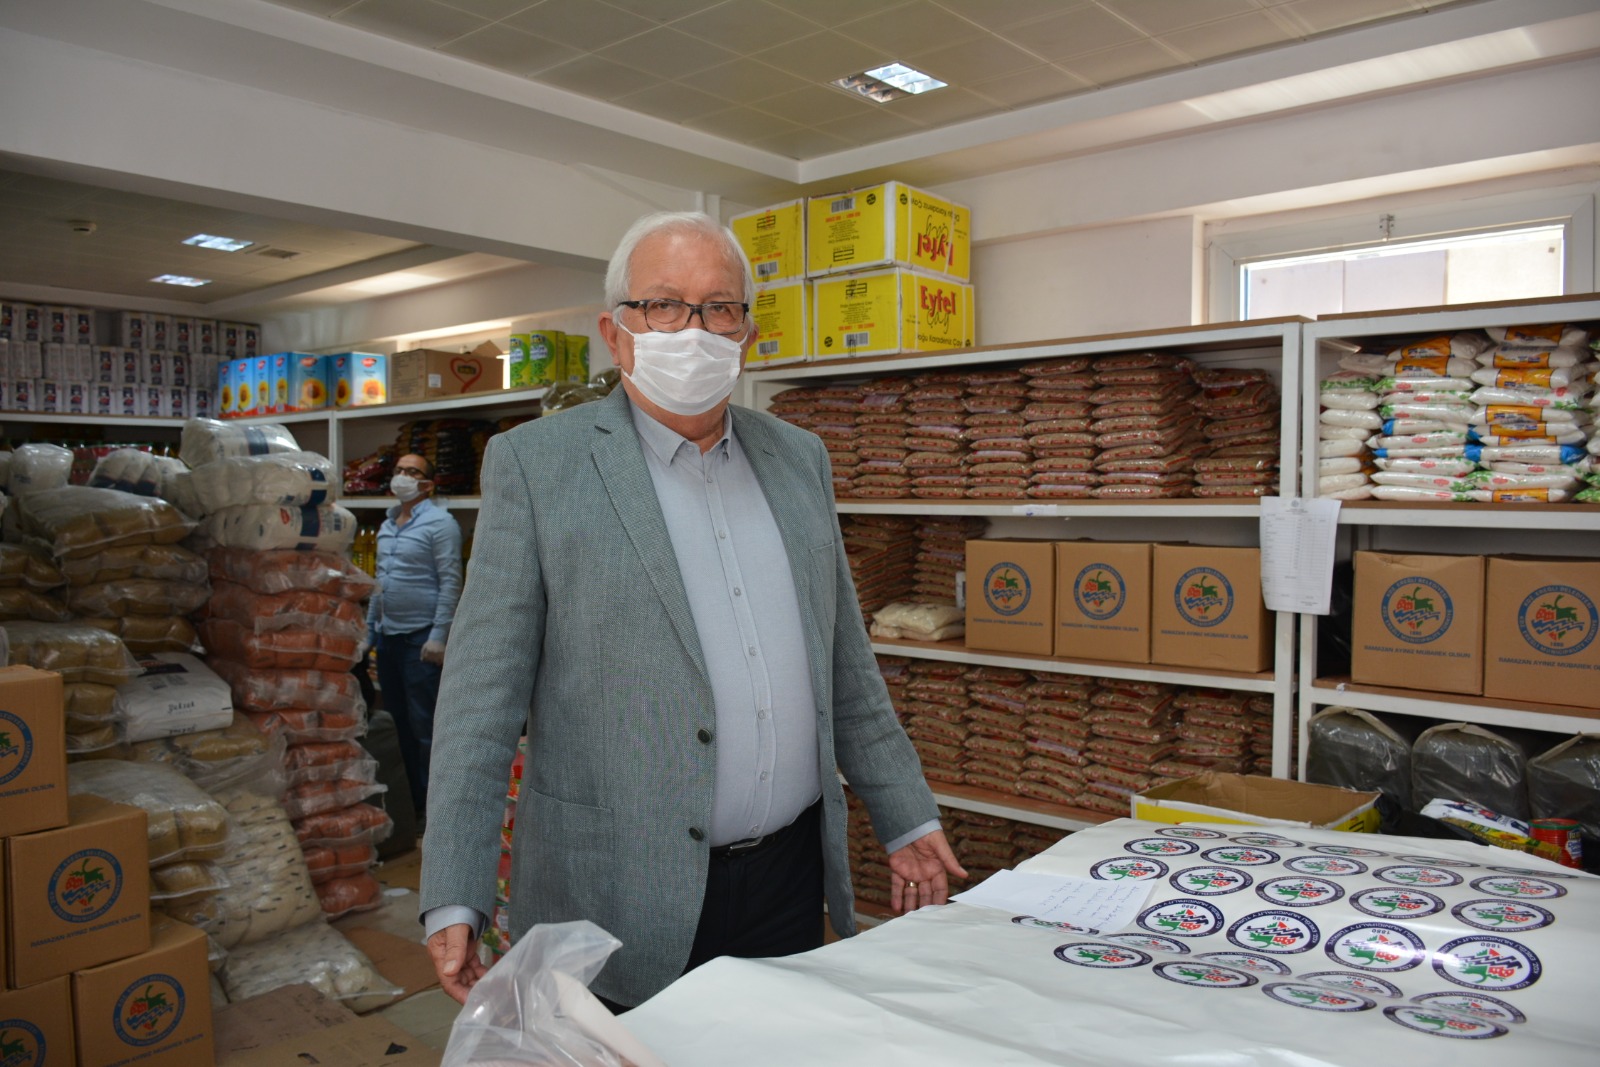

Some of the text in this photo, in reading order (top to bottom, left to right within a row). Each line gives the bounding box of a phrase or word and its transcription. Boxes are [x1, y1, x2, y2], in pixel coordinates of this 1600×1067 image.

[920, 285, 956, 317] Eyfel
[926, 309, 950, 334] Çay
[1364, 645, 1393, 653] RAMAZAN
[1498, 657, 1532, 665] RAMAZAN
[1252, 910, 1301, 920] MUNICIPALITY
[1350, 922, 1403, 932] MUNICIPALITY
[1457, 936, 1514, 946] MUNICIPALITY
